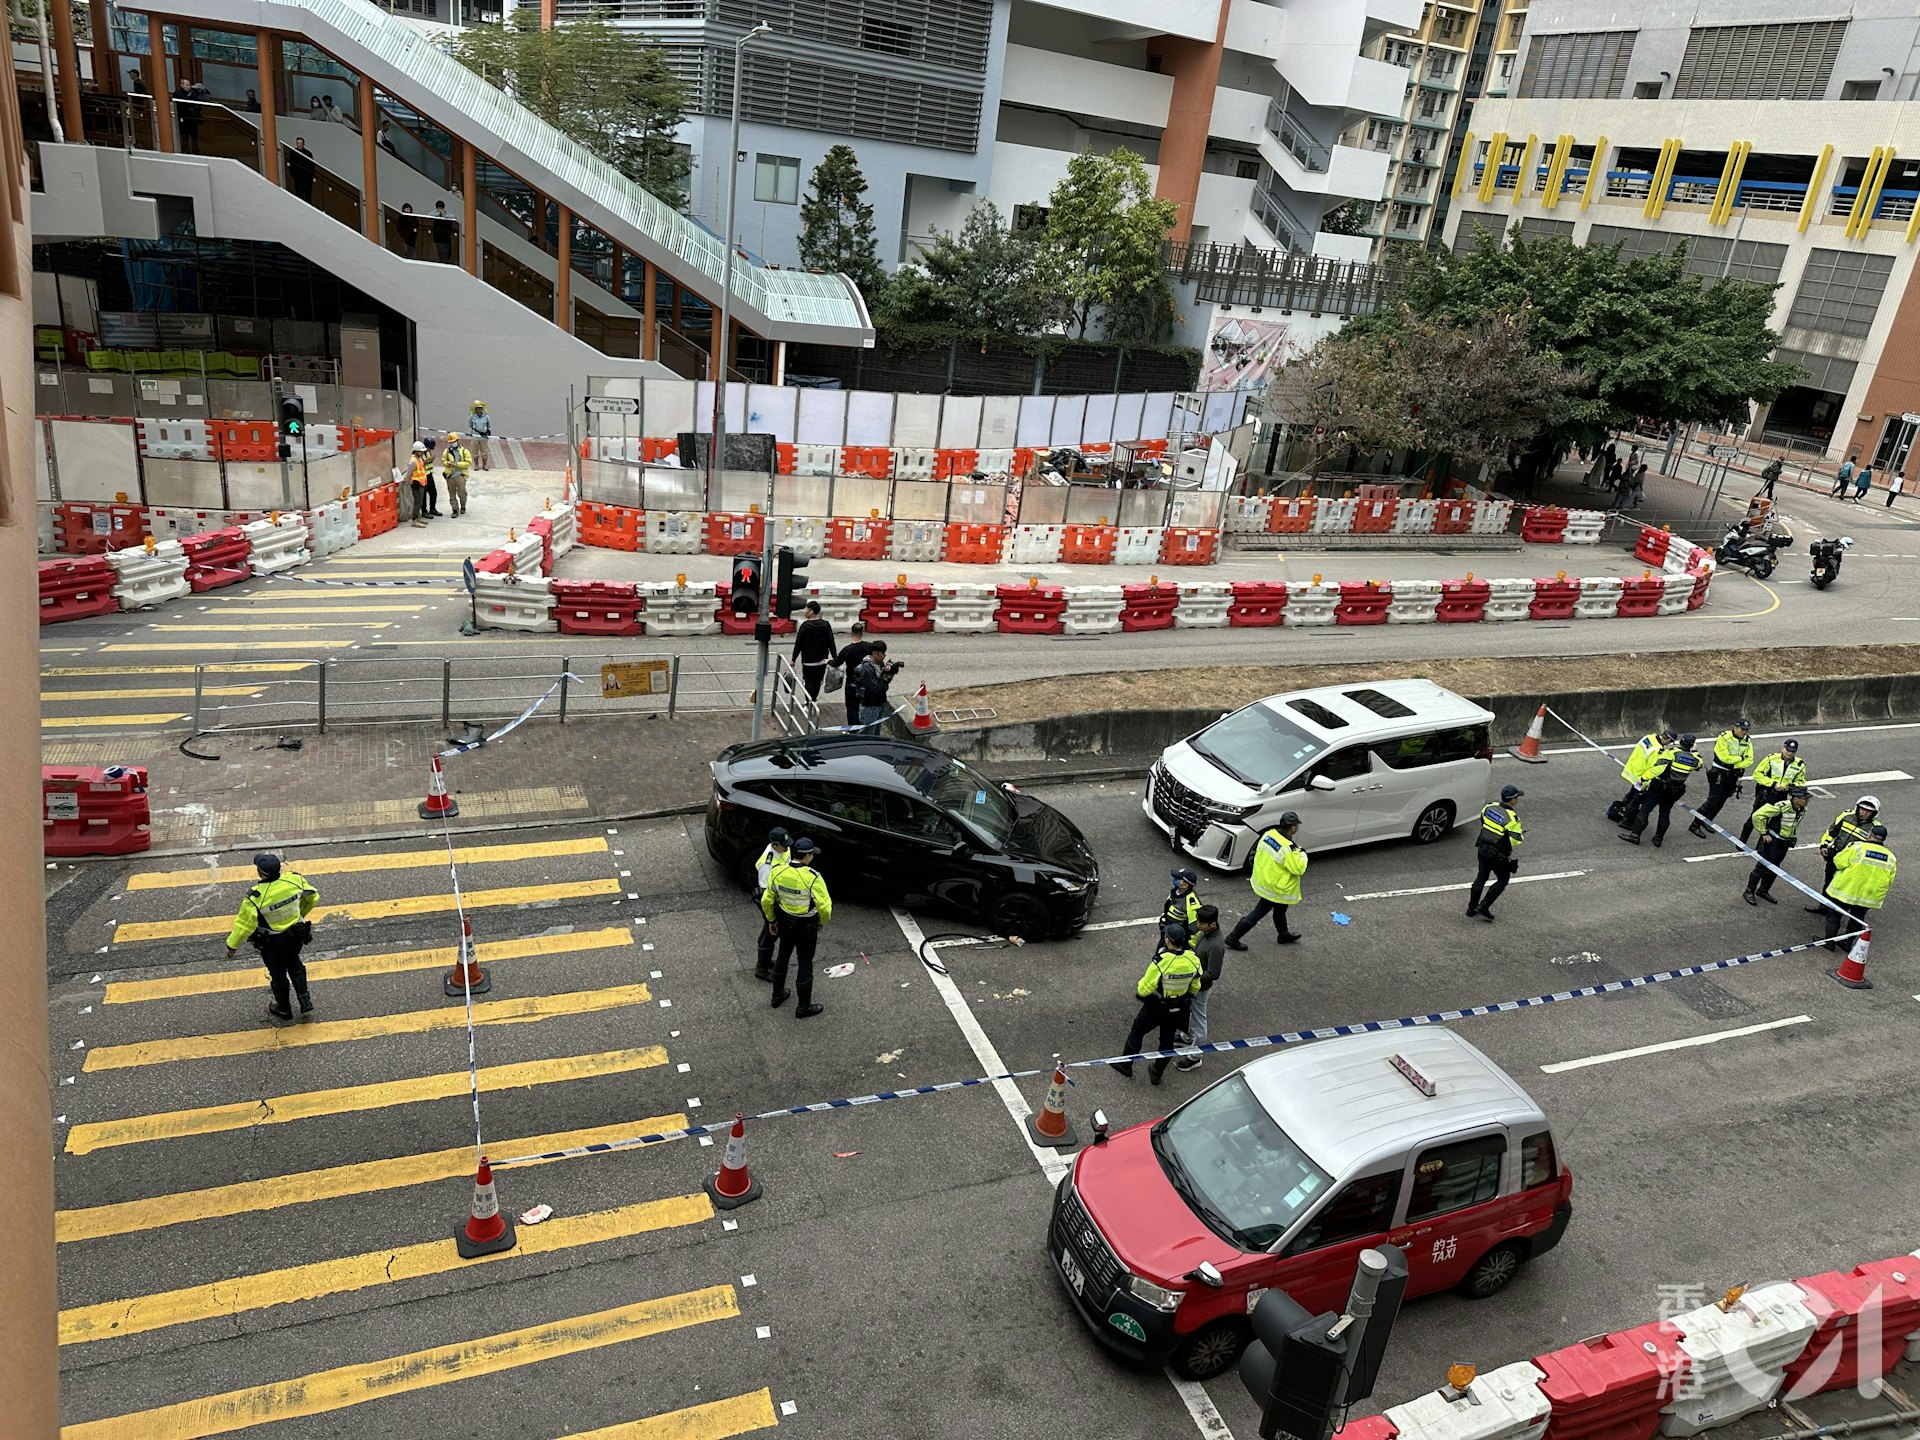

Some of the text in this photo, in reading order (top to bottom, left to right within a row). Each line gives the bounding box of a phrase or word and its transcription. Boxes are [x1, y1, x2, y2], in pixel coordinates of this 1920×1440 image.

[1396, 1055, 1428, 1090] TAXI
[1433, 1235, 1458, 1252] 的士
[1431, 1246, 1457, 1264] TAXI
